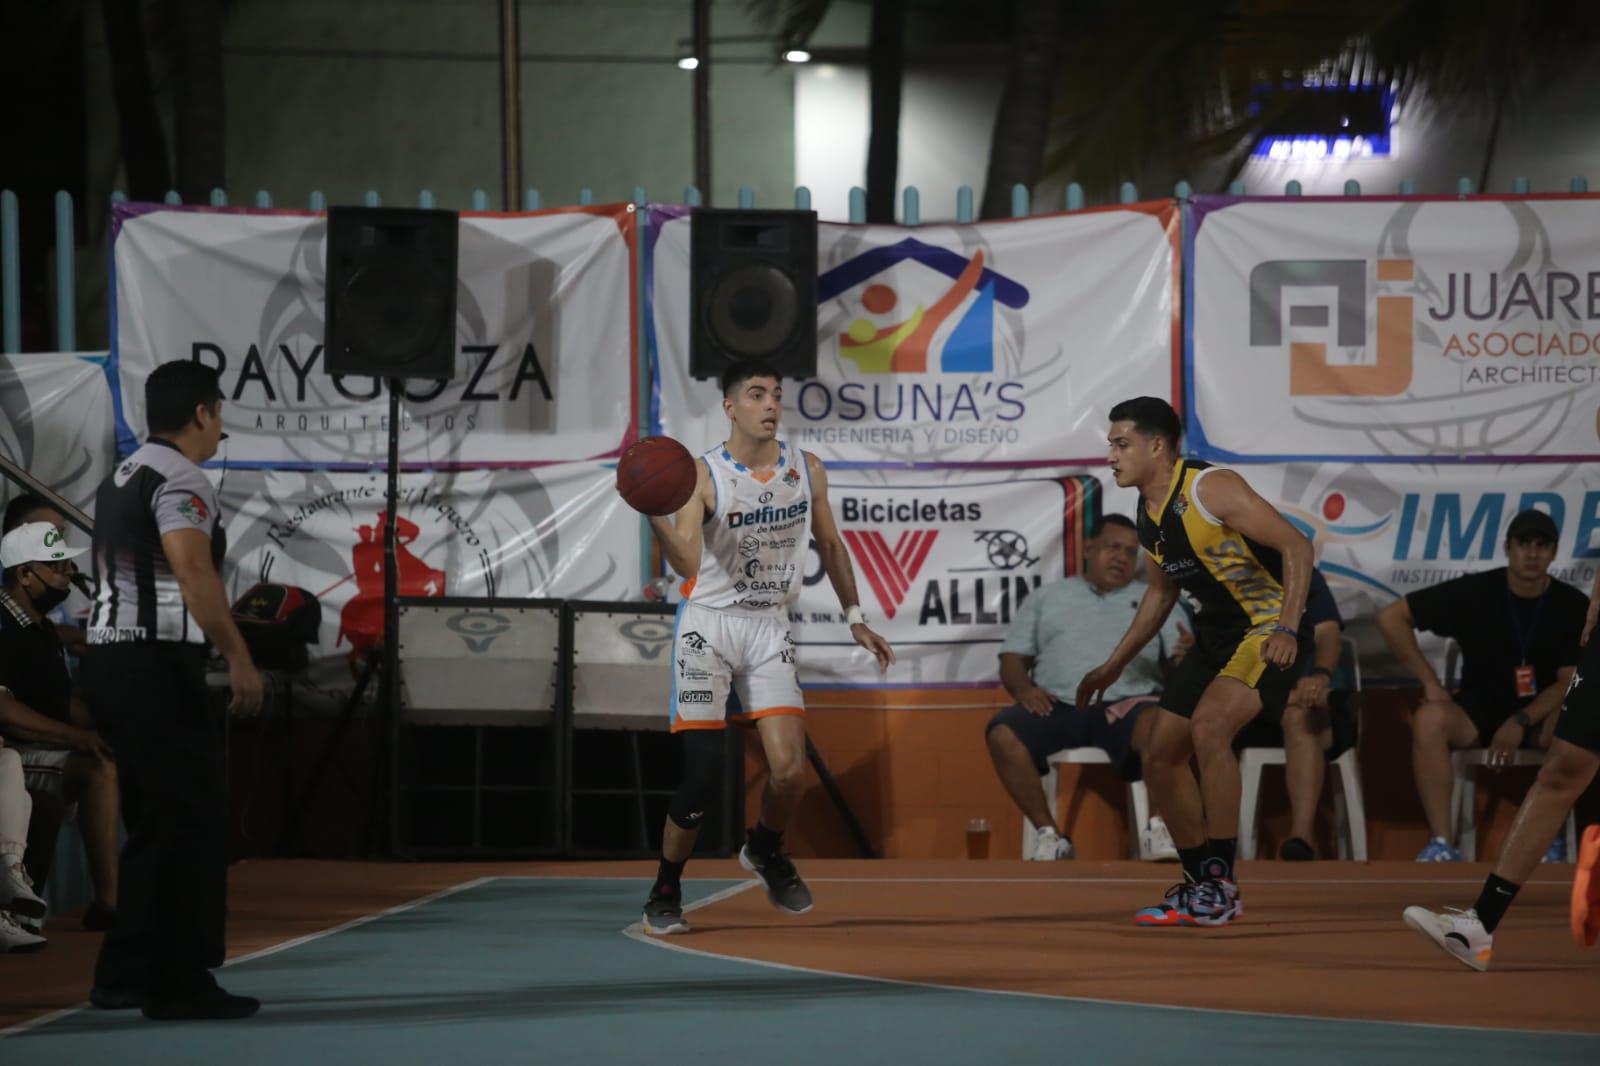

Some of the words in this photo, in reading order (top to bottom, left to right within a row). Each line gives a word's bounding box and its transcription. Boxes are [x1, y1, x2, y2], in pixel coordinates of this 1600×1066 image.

[1466, 365, 1600, 384] ARCHITECT
[797, 381, 1026, 422] OSUNA'S
[255, 413, 477, 432] ARQUITECTOS
[802, 427, 914, 445] INGENIERIA
[923, 427, 937, 444] Y
[728, 500, 808, 529] Delfines
[842, 497, 982, 523] Bicicletas
[1391, 568, 1479, 585] INSTITU
